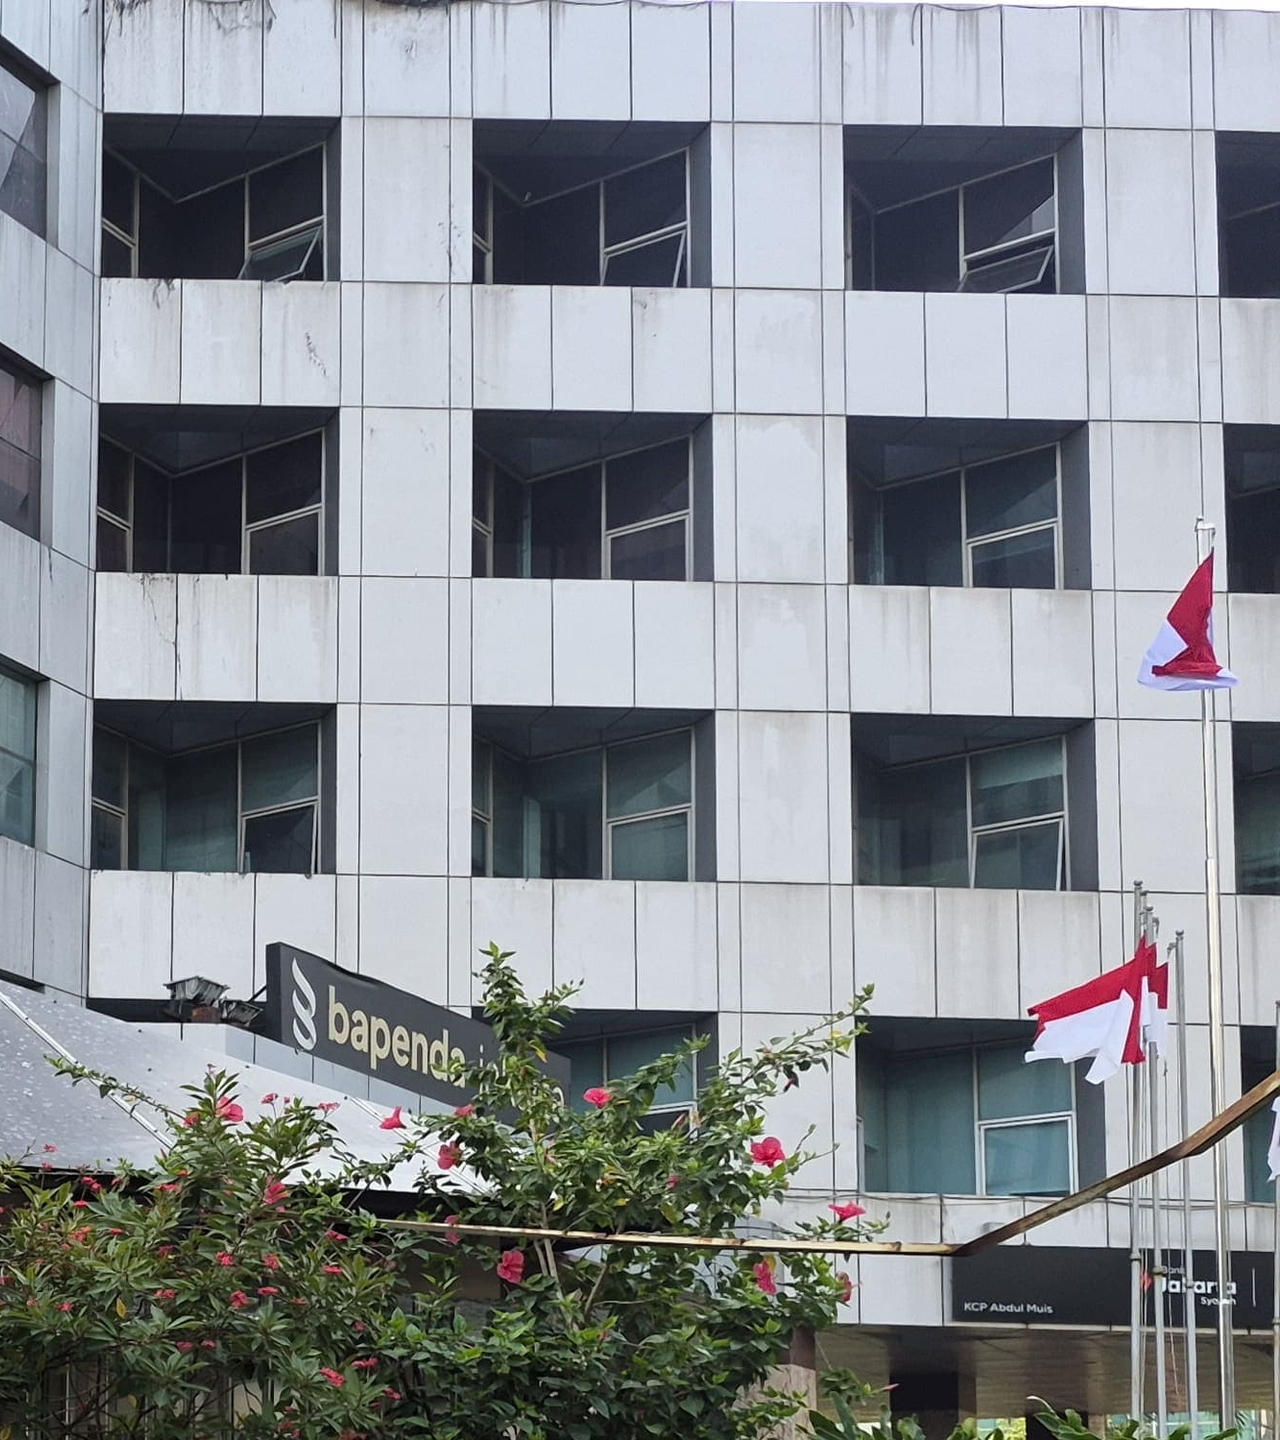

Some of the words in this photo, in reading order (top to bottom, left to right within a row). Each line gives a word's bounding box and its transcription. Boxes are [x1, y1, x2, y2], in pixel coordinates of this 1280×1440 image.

[328, 985, 466, 1089] bapenda
[1160, 1276, 1237, 1295] Jaara
[964, 1302, 987, 1312] KCP
[989, 1303, 1024, 1313] Abdul
[1027, 1303, 1053, 1314] Muis
